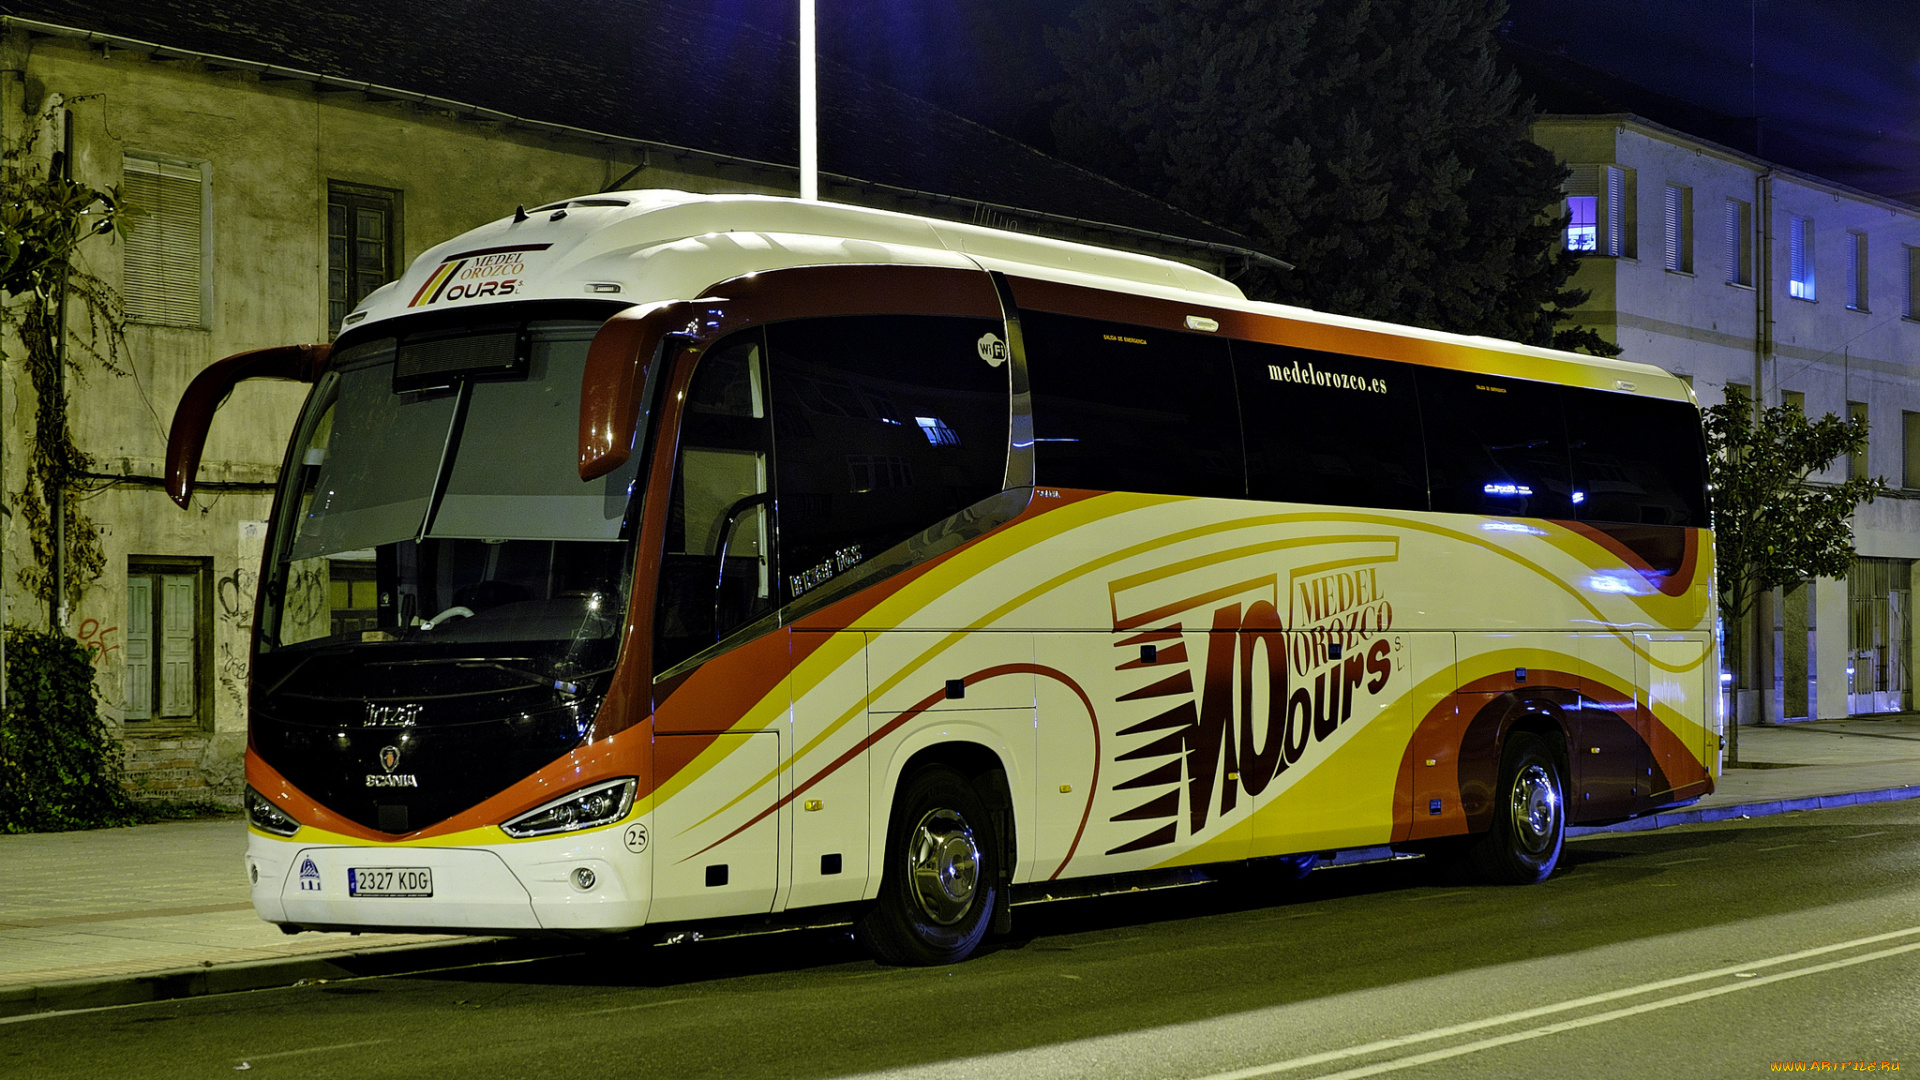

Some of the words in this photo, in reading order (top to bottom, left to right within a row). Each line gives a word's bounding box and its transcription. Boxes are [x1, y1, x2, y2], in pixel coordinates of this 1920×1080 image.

[473, 253, 524, 268] MEDEL
[460, 263, 524, 281] OROZCO
[1267, 360, 1387, 394] medelorozco.es
[1298, 567, 1385, 627] MEDEL
[1293, 600, 1393, 677] OROZCO
[365, 774, 418, 788] SCANIA
[628, 830, 646, 846] 25
[359, 872, 393, 890] 2327
[398, 872, 428, 890] KDG
